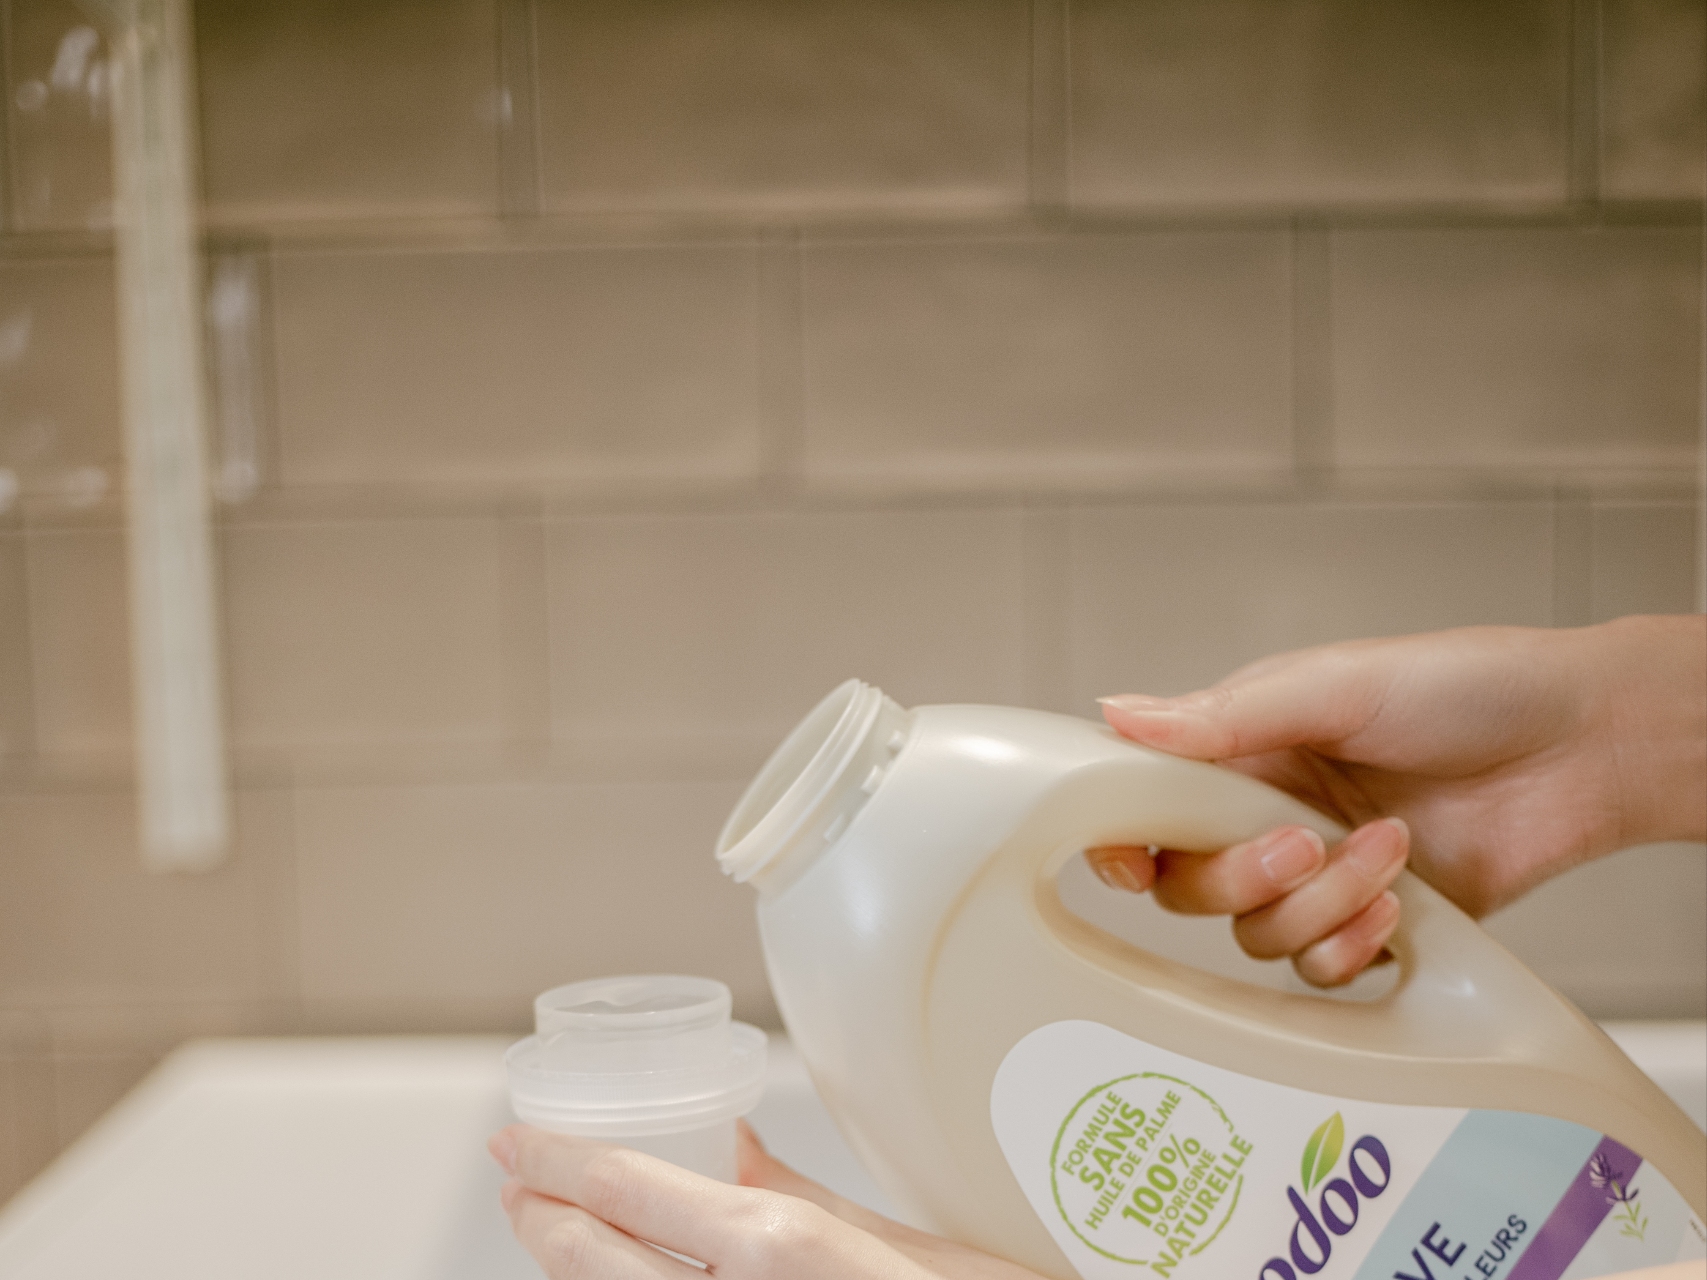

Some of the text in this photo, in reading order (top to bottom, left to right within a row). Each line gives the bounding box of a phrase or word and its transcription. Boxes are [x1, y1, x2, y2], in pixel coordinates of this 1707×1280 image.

[1061, 1091, 1122, 1175] FORMULE
[1079, 1102, 1146, 1192] SANS
[1084, 1090, 1181, 1230] HUILE DE PALME
[1121, 1133, 1201, 1227] 100%
[1151, 1135, 1253, 1279] NATURELLE
[1153, 1149, 1216, 1237] D'ORIGINE
